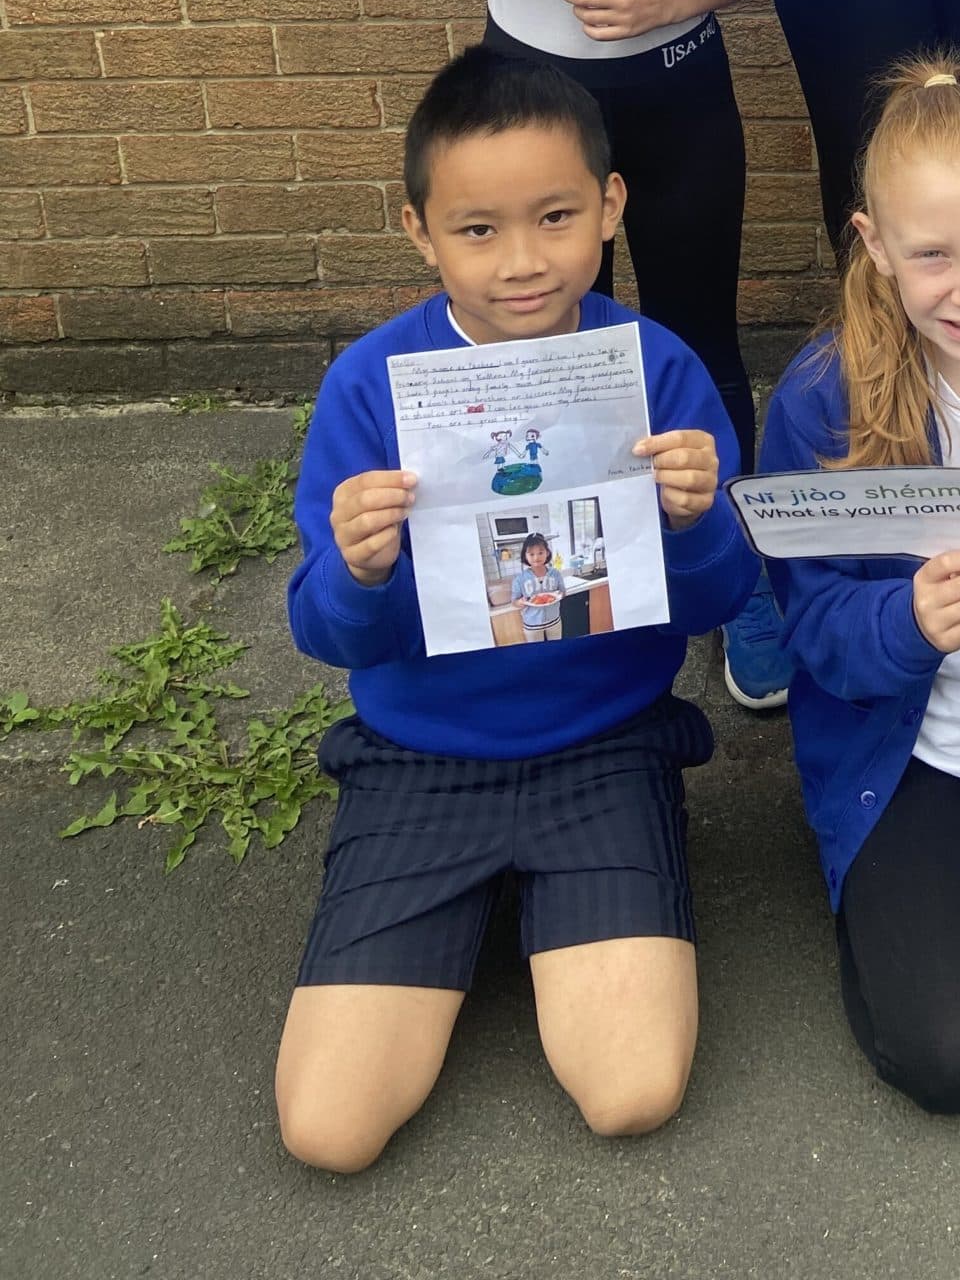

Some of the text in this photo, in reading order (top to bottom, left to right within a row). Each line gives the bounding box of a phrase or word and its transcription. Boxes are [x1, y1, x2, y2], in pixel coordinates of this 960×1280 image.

[662, 40, 697, 68] USA
[791, 486, 846, 506] jiào
[753, 507, 816, 520] What
[821, 506, 839, 517] is
[846, 504, 897, 519] your
